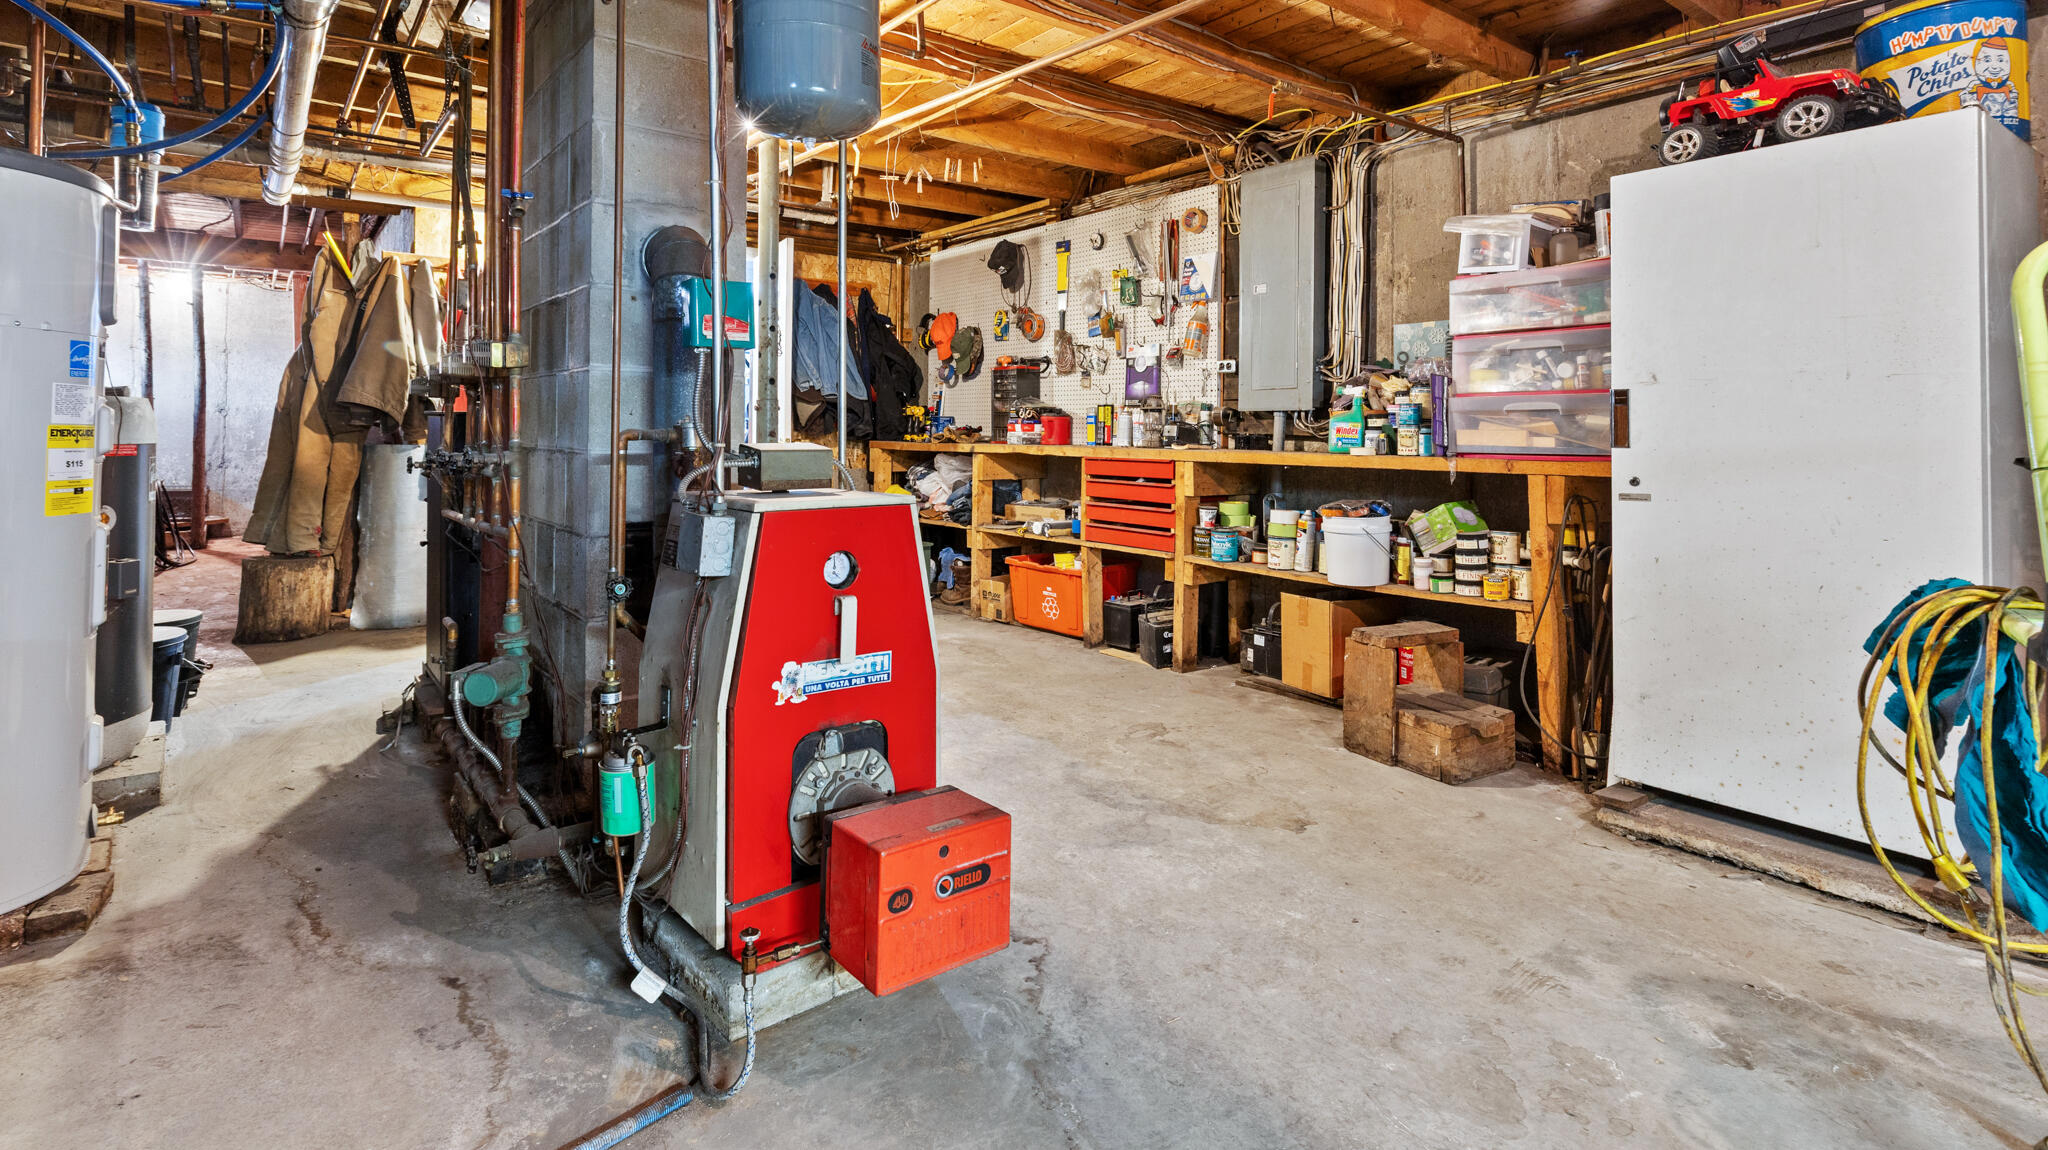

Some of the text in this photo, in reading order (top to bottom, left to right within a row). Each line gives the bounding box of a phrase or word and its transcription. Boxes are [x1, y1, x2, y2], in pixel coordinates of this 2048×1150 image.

[1890, 17, 2017, 55] HUMPTY DUMPTY
[1907, 52, 1969, 88] Potato
[1917, 67, 1972, 97] Chips
[1336, 427, 1358, 435] Windex
[805, 673, 888, 694] UNA VOLTA PER TUTTE
[954, 870, 982, 889] RIELLO
[892, 893, 909, 909] 40
